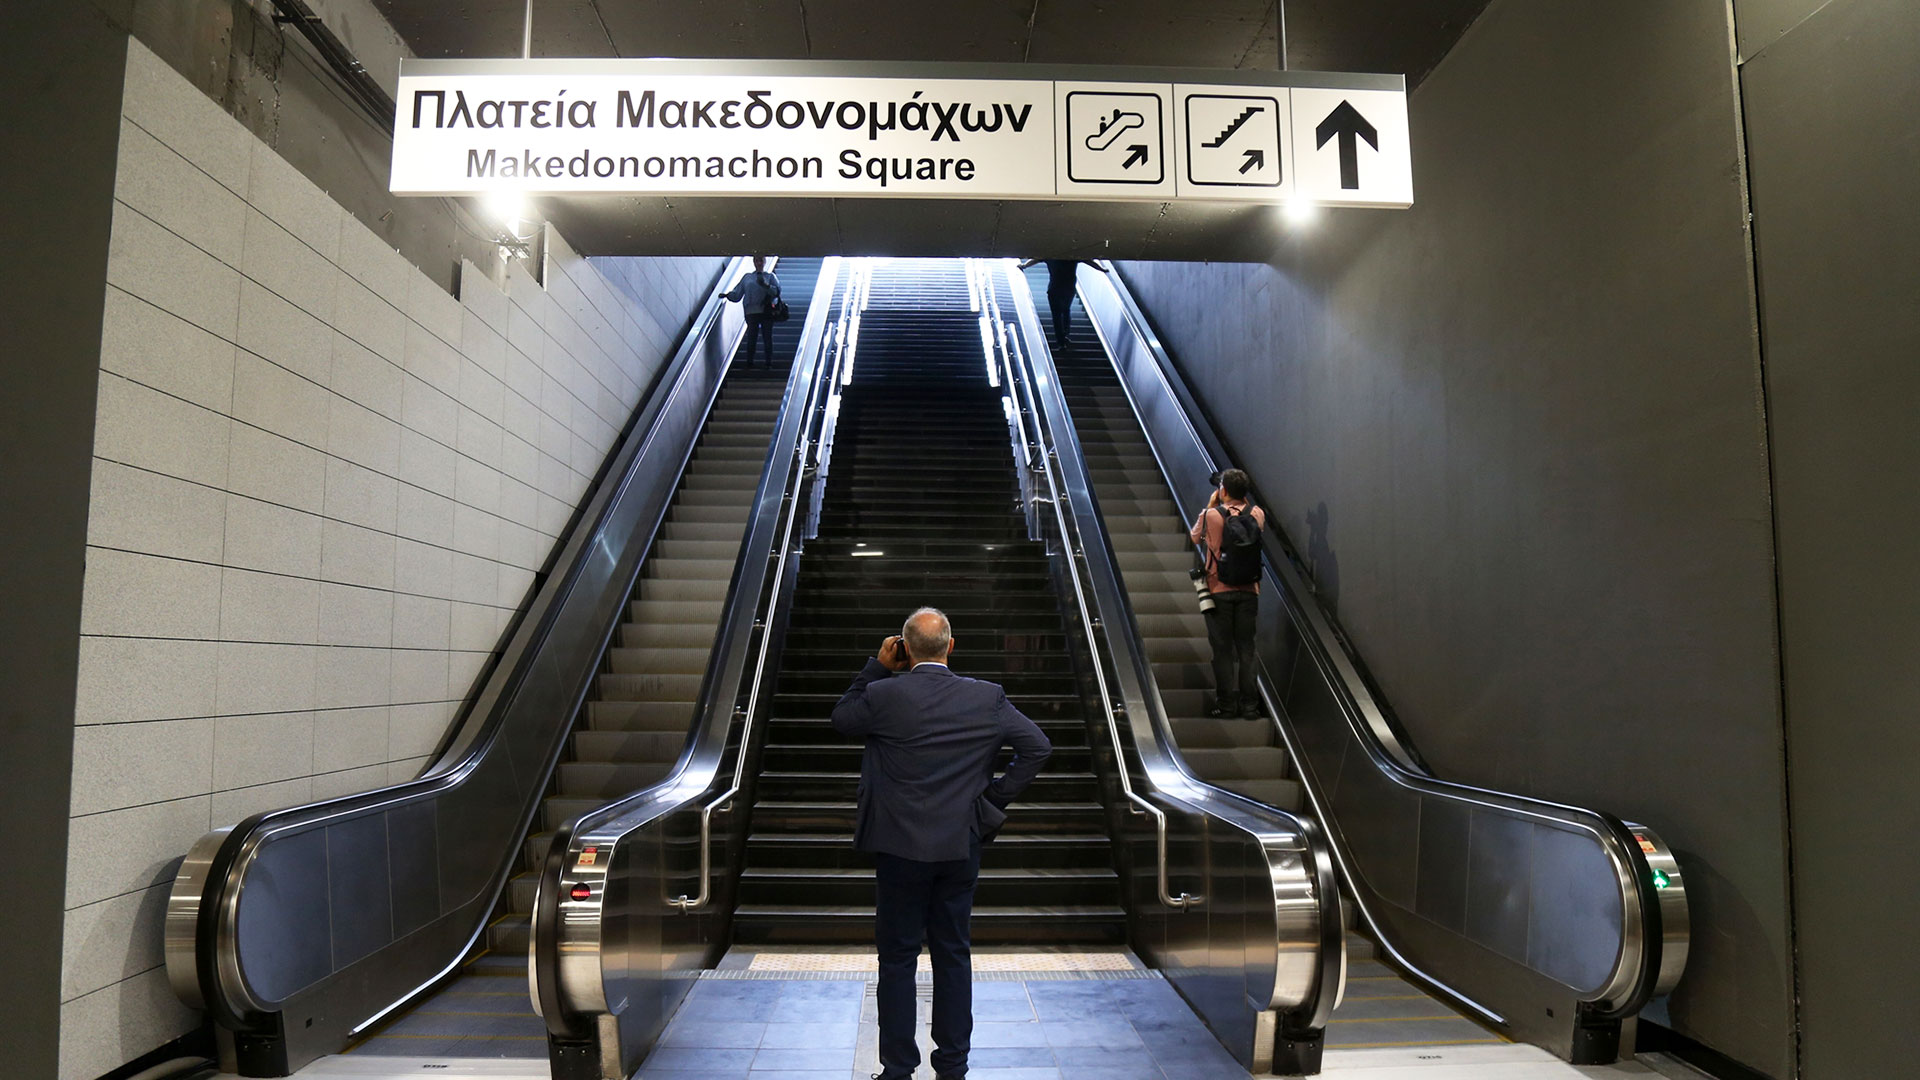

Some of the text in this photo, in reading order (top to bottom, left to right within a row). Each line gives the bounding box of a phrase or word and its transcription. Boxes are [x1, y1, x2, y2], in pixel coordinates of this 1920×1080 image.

[413, 90, 1033, 142] Πλατεία Μακεδονομάχων
[467, 149, 975, 187] Makedonomachon Square
